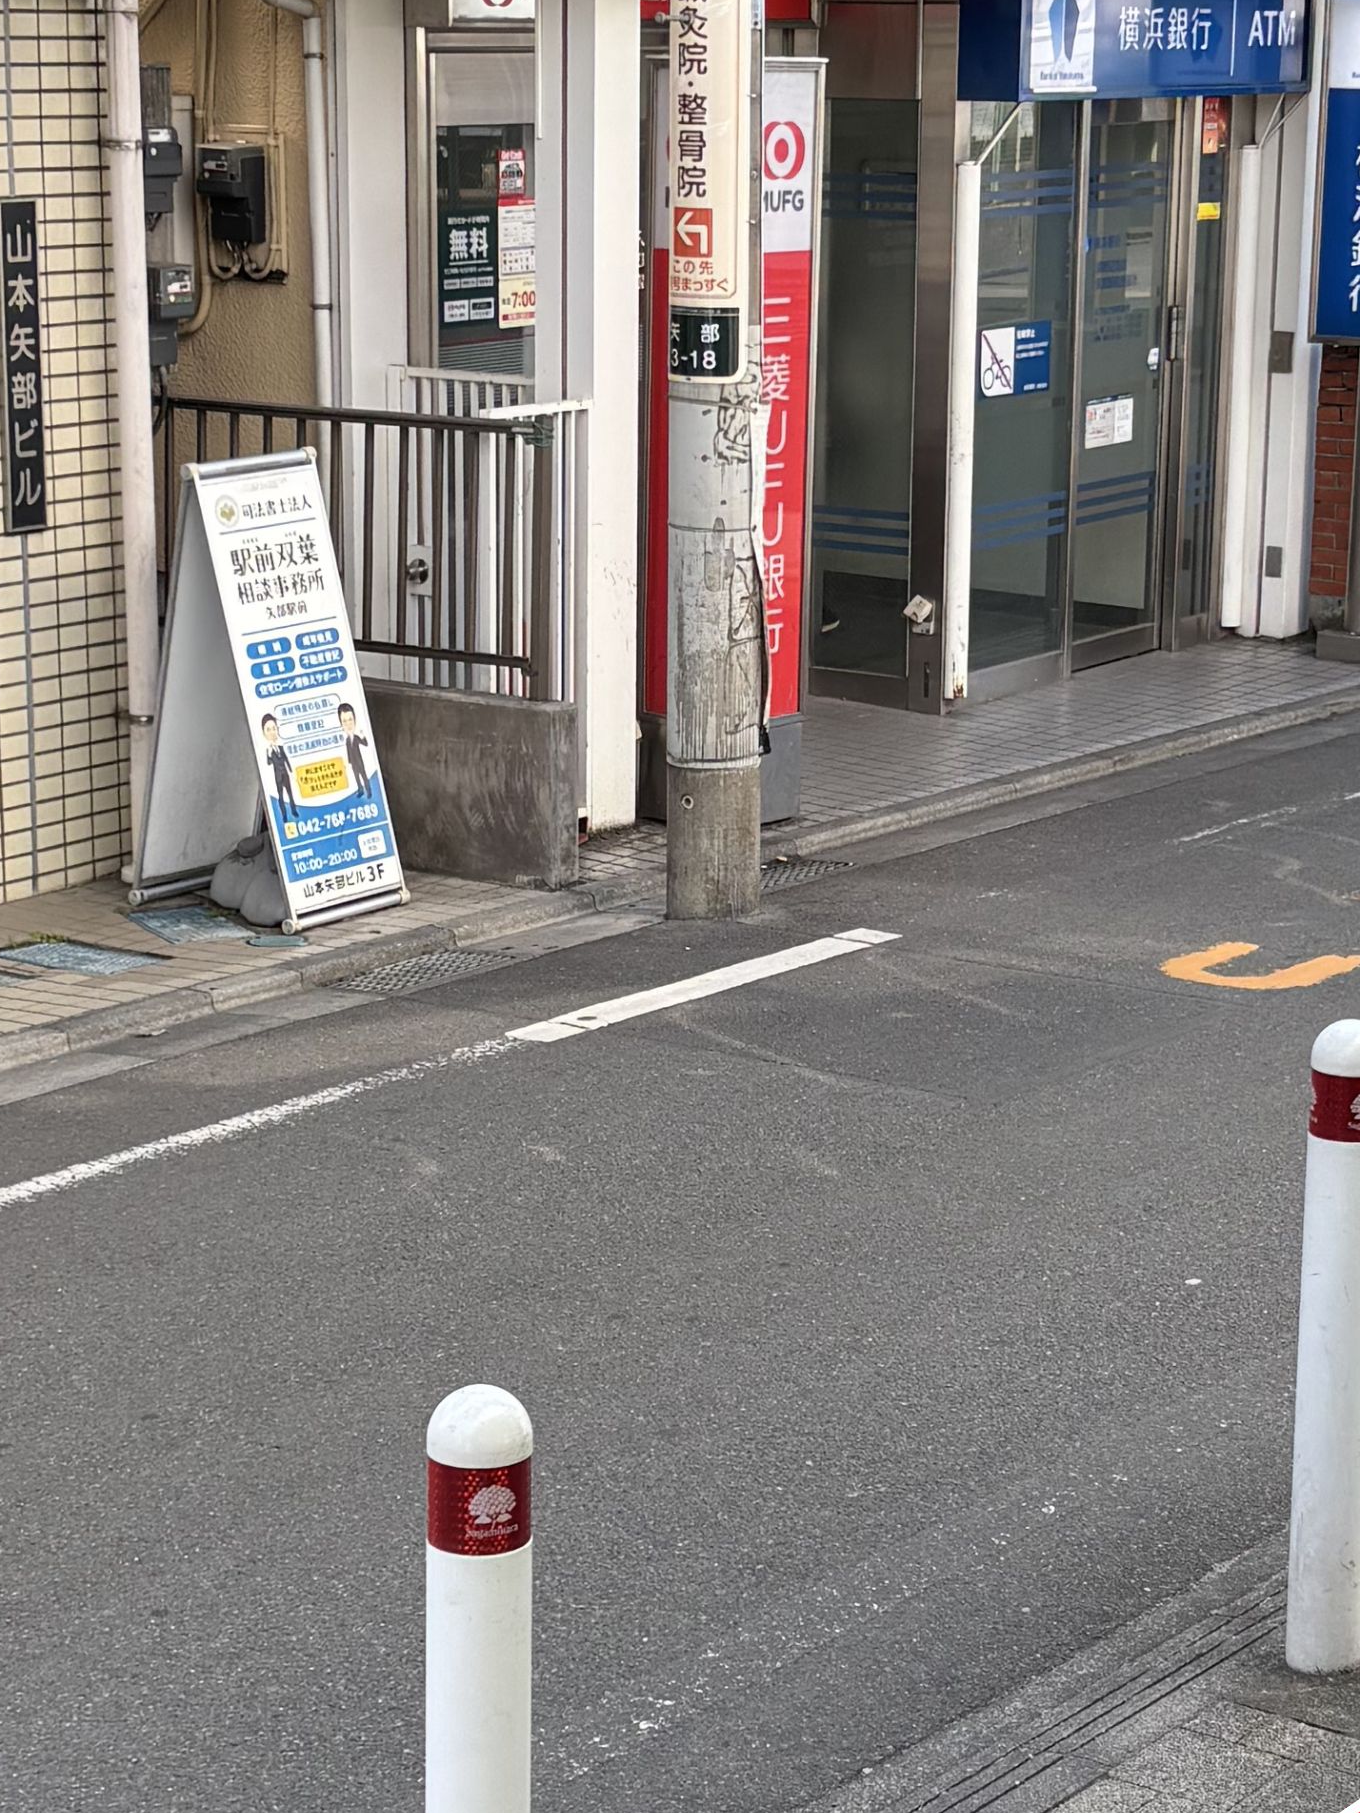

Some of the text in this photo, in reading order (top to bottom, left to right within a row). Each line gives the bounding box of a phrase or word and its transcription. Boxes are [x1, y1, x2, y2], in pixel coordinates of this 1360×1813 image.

[1119, 6, 1212, 52] 横浜銀行
[1247, 10, 1296, 48] ATM
[448, 227, 489, 261] 無料
[3, 225, 43, 510] 山本矢部ビル
[242, 494, 312, 519] 司法書士法人
[230, 533, 319, 577] 駅前双葉
[237, 568, 325, 605] 相談事務所
